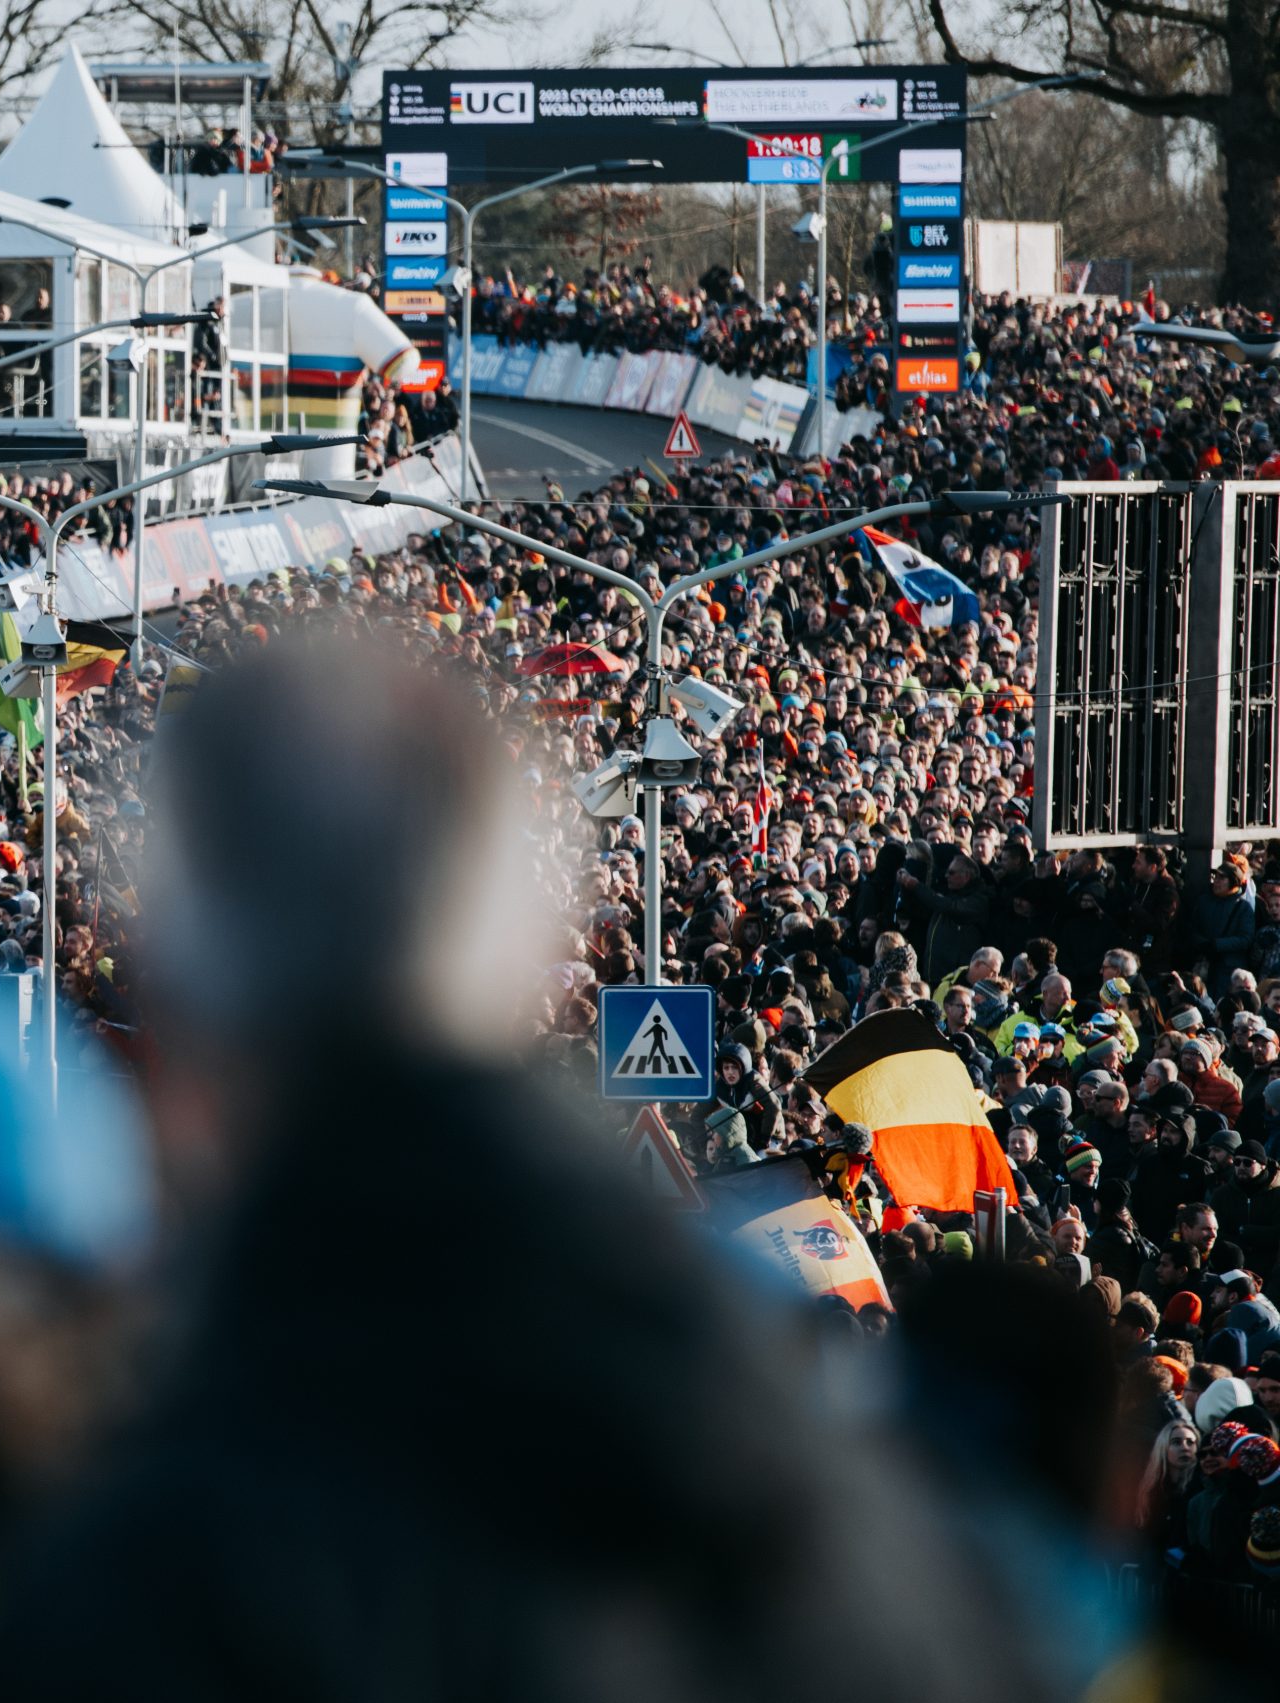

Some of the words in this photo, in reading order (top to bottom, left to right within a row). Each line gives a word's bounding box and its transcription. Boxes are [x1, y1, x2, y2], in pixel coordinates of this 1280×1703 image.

[466, 92, 526, 113] UCI
[539, 88, 569, 101] 2023
[570, 87, 665, 101] CYCLO-CROSS
[539, 102, 588, 116] WORLD
[589, 101, 699, 116] CHAMPIONSHIPS
[832, 139, 848, 176] 1
[763, 1225, 808, 1286] Jupiler
